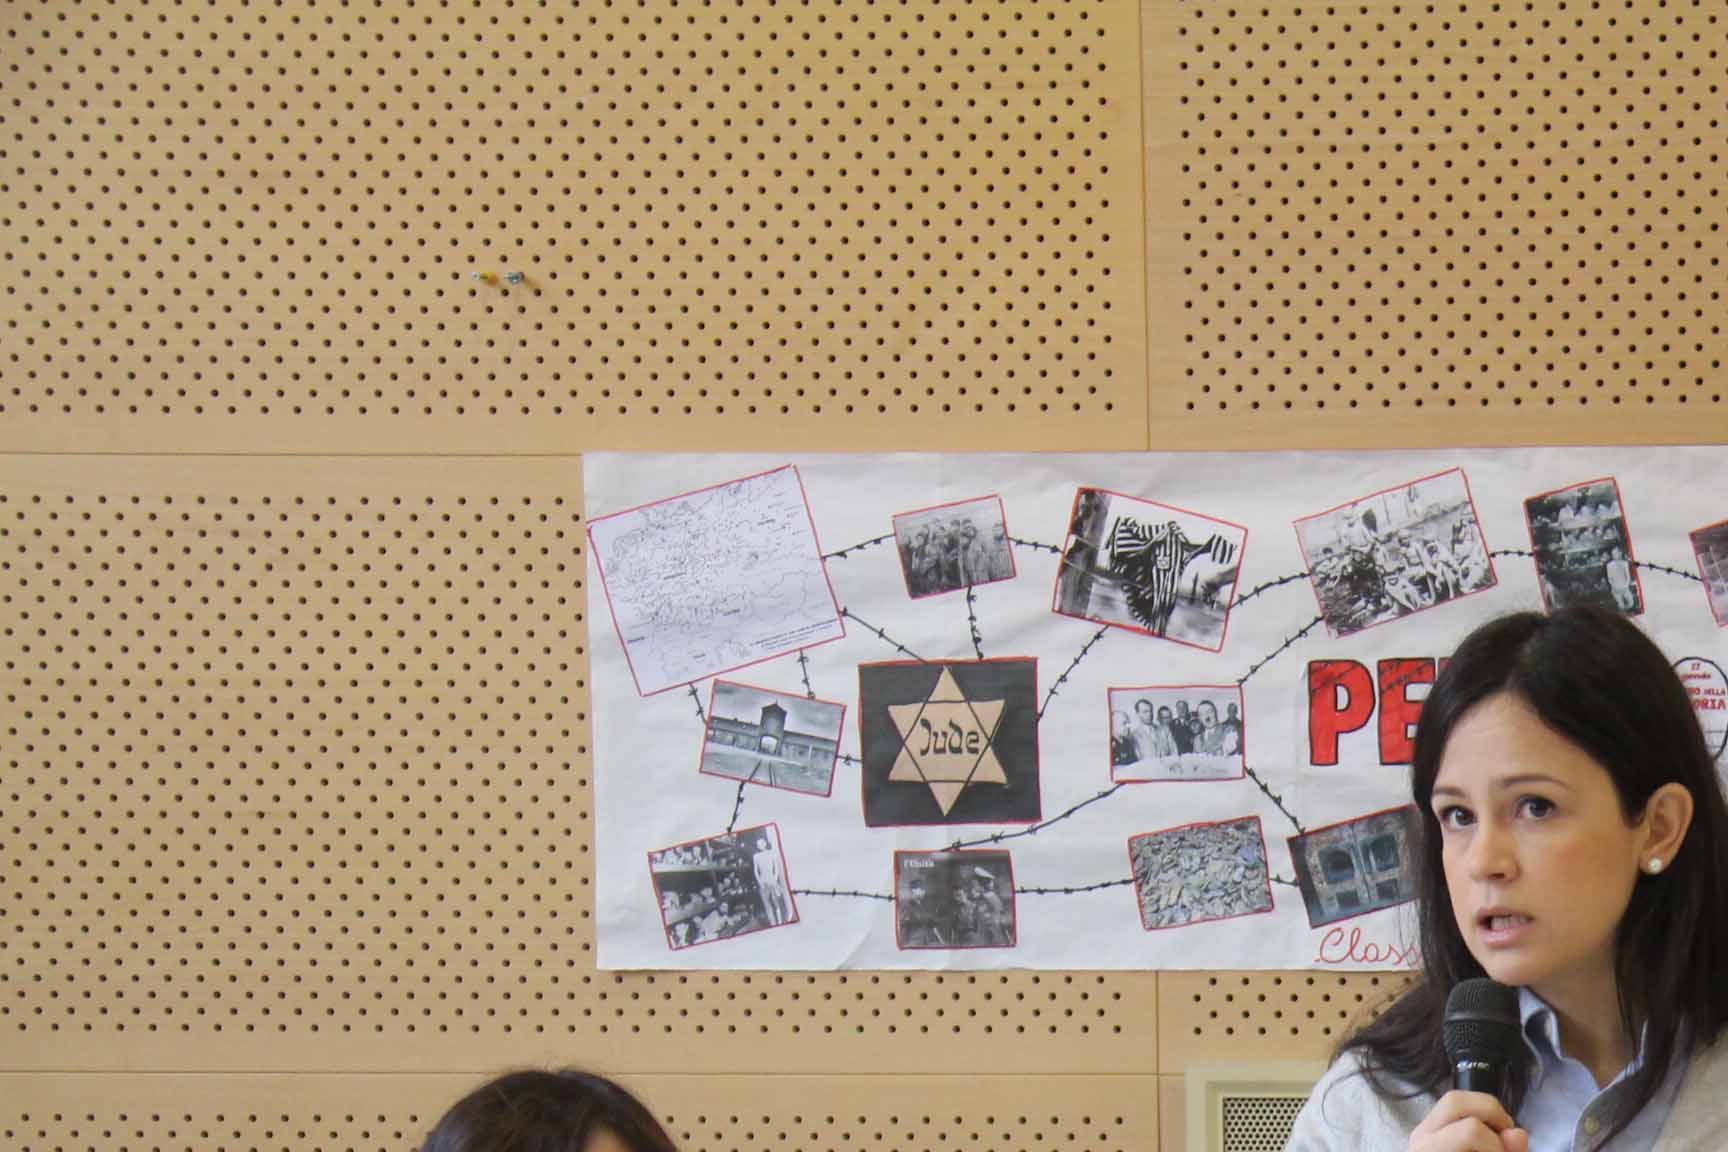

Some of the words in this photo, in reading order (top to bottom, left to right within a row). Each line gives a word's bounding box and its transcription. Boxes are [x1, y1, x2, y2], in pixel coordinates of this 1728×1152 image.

[1308, 656, 1455, 765] PE
[920, 718, 980, 756] Jude
[1313, 927, 1424, 966] Class
